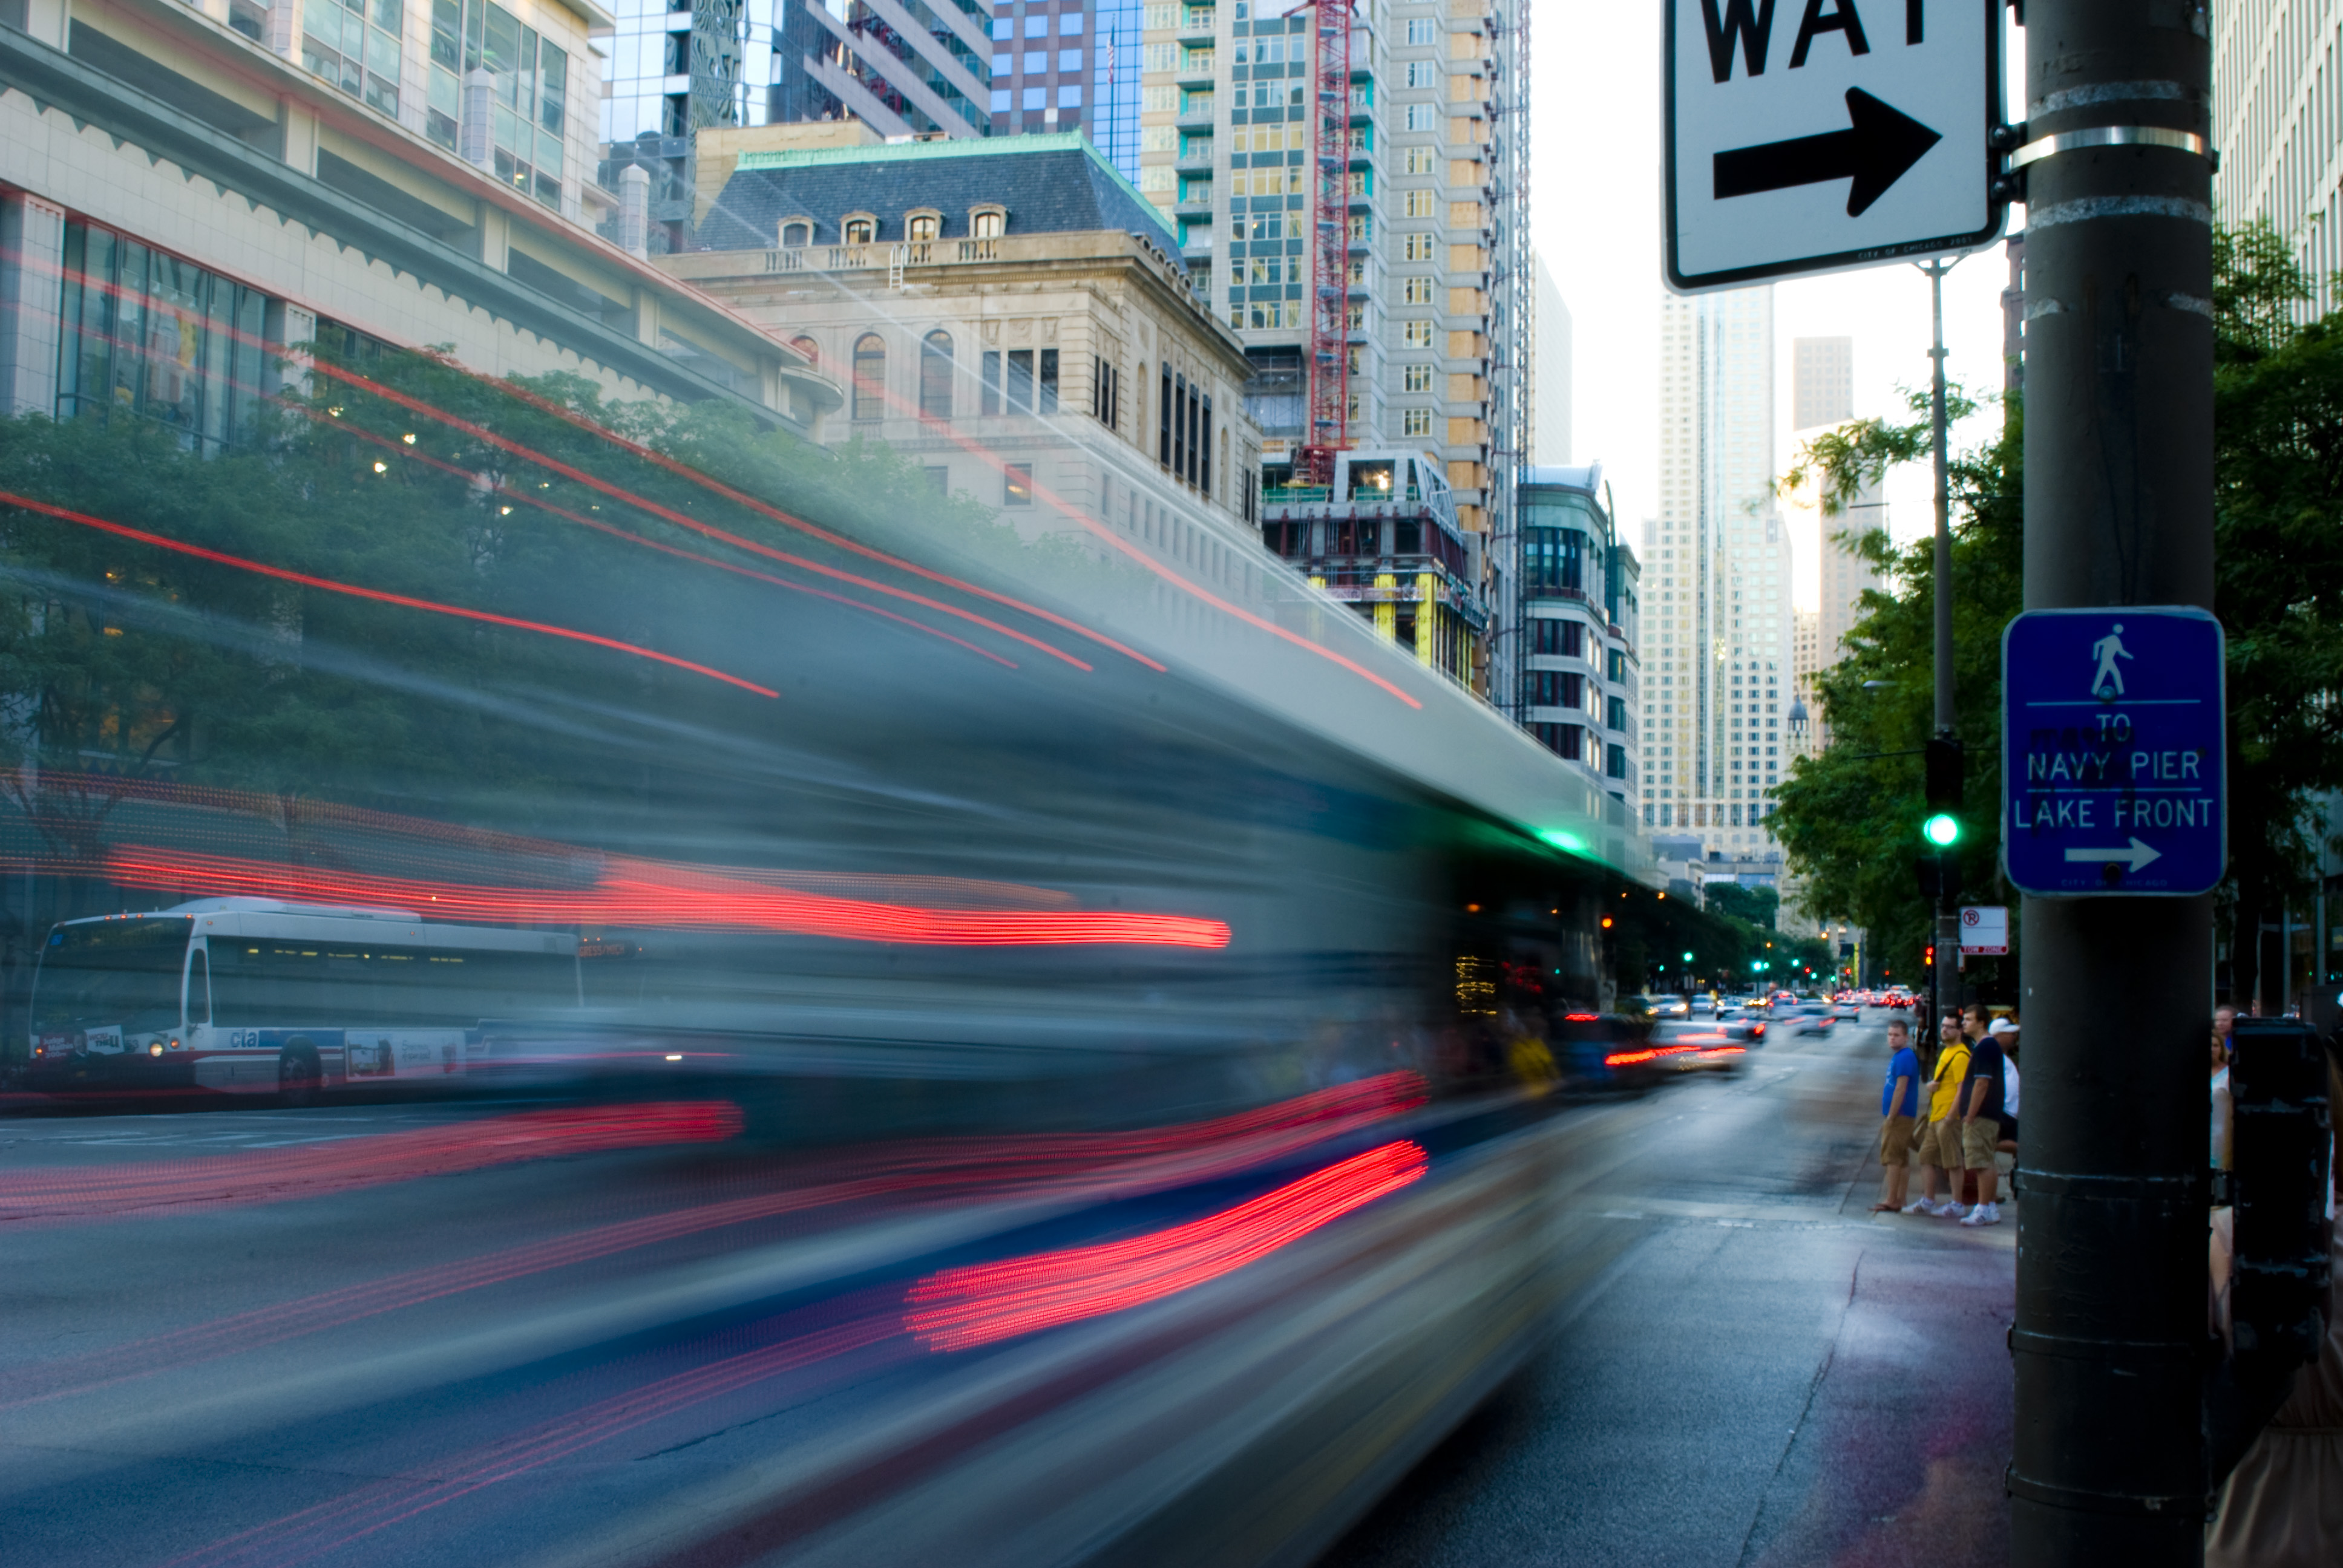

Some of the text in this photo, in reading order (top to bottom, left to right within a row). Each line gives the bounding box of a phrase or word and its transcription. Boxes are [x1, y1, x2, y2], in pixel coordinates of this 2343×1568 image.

[1858, 250, 1878, 260] CITY
[1885, 247, 1896, 256] OF
[1903, 241, 1943, 253] CHICAGO
[2096, 714, 2131, 742] TO
[2028, 751, 2199, 780] NAVY PIER
[2015, 799, 2214, 828] LAKE FRONT
